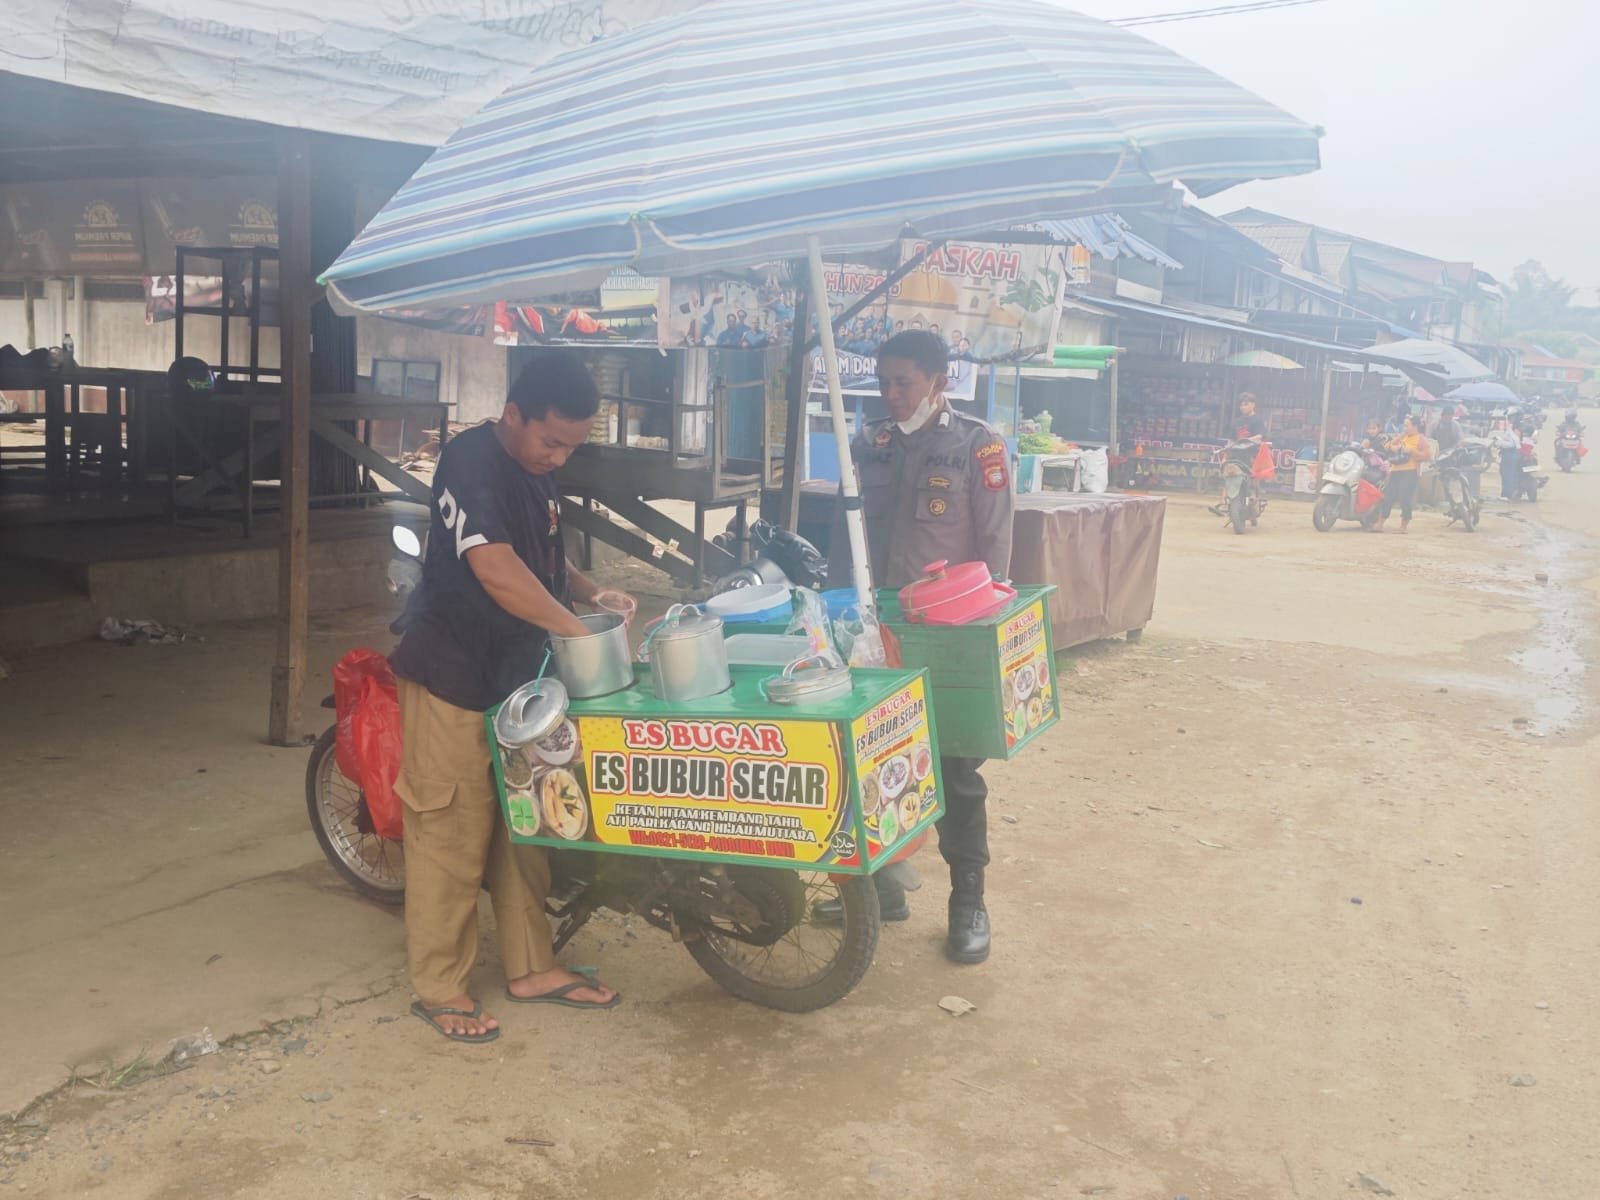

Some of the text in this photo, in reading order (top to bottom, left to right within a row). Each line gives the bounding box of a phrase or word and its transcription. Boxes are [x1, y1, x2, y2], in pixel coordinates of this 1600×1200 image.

[822, 271, 863, 294] HUN
[925, 455, 968, 472] POLRI
[866, 690, 912, 727] ES BUGAR
[627, 720, 785, 754] ES BUGAR
[856, 734, 867, 755] ES
[867, 716, 899, 746] BUBUR
[900, 700, 924, 727] SEGAR
[592, 754, 827, 806] ES BUBUR SEGAR
[607, 815, 626, 827] ATI
[615, 804, 656, 818] KETAN
